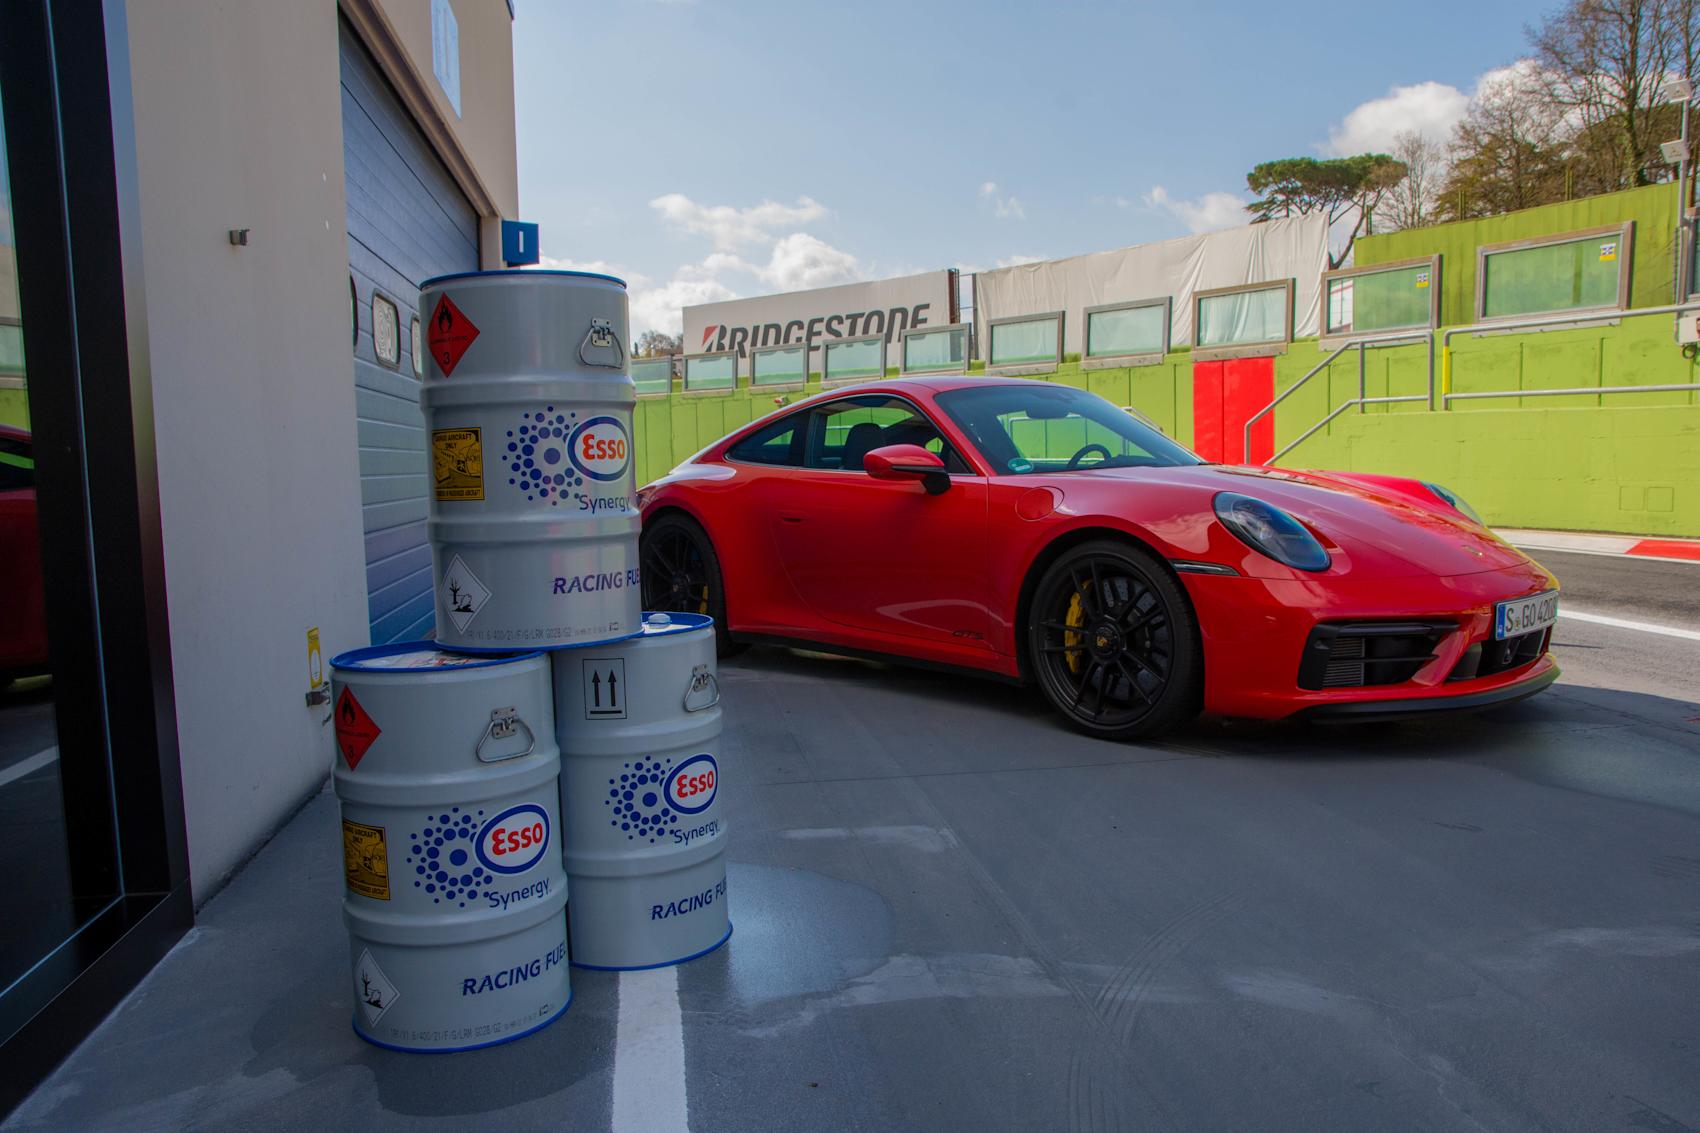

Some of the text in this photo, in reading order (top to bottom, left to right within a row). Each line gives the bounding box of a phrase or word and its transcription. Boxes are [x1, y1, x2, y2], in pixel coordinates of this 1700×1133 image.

[443, 352, 450, 364] 3
[579, 495, 630, 514] Synergy
[553, 568, 640, 594] RACING FUE
[1506, 607, 1514, 632] S
[674, 819, 719, 846] Synergy
[488, 878, 549, 910] Synergy
[651, 888, 712, 920] RACING
[462, 958, 541, 996] RACING
